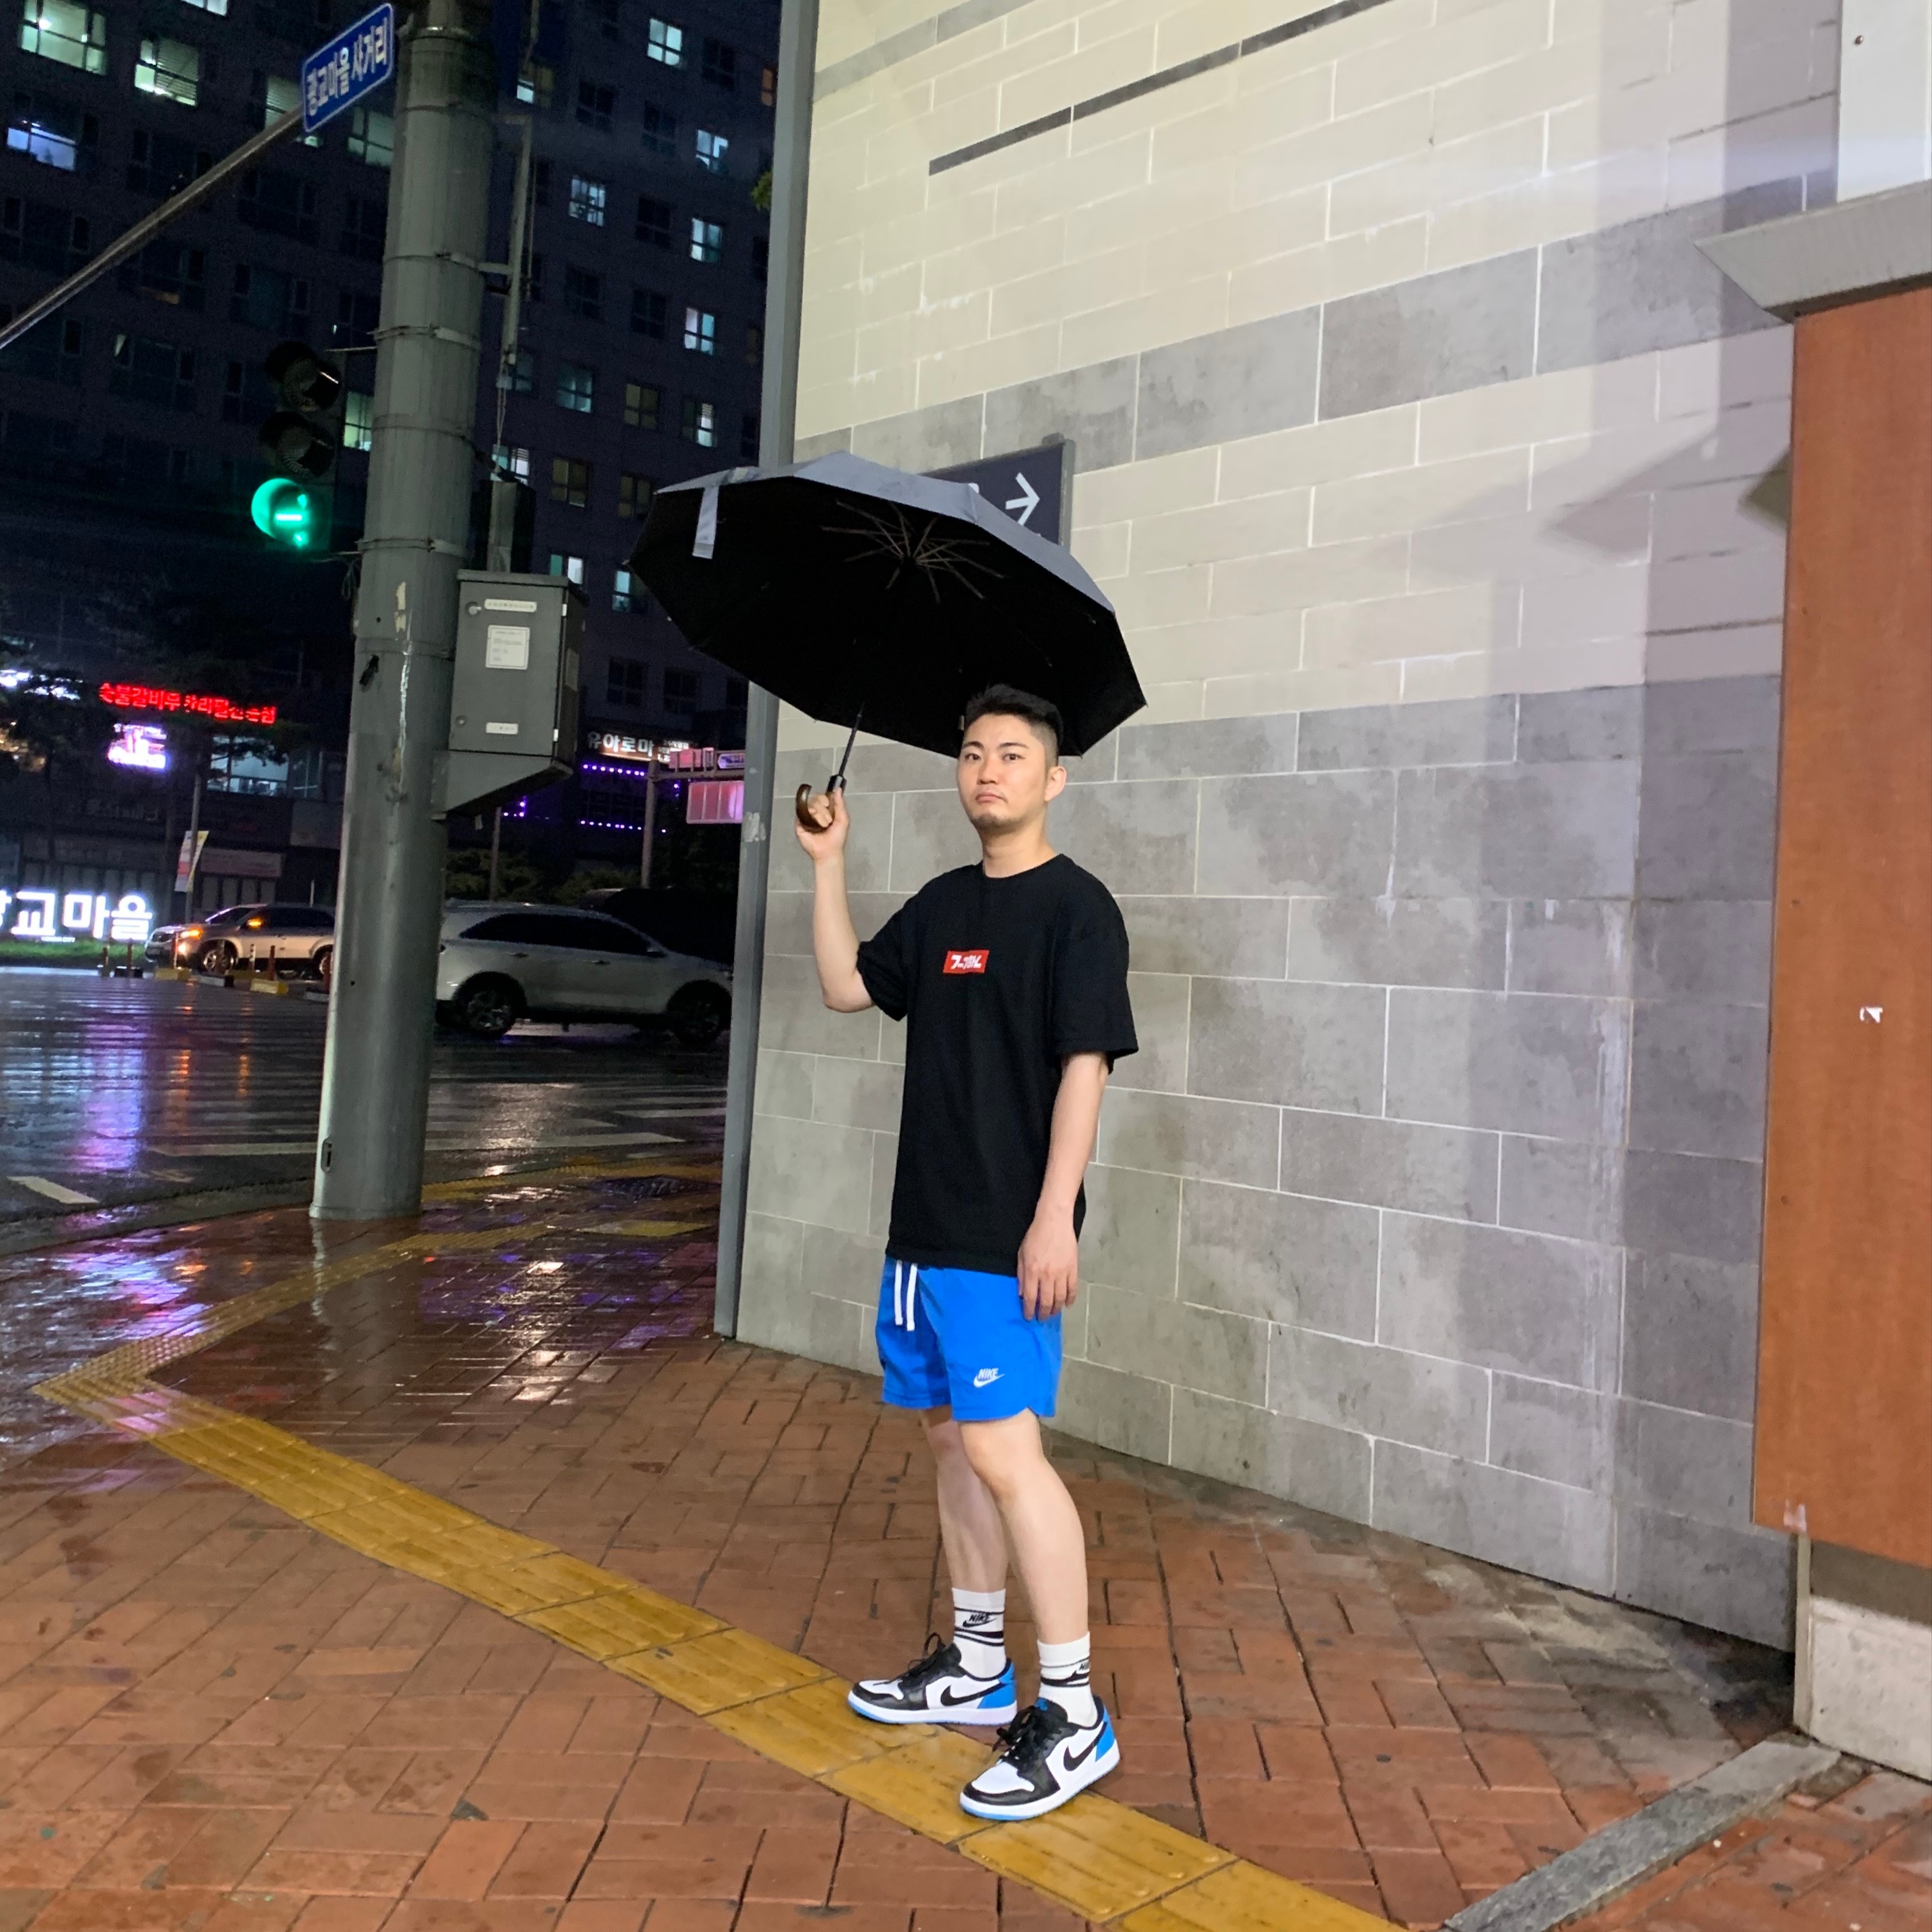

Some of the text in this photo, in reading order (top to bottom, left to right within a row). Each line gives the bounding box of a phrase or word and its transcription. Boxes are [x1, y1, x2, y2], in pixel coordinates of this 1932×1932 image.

[351, 17, 387, 82] 사거리
[586, 731, 654, 757] 유아로마
[977, 1368, 999, 1379] NIKE
[969, 1613, 990, 1621] NIKE
